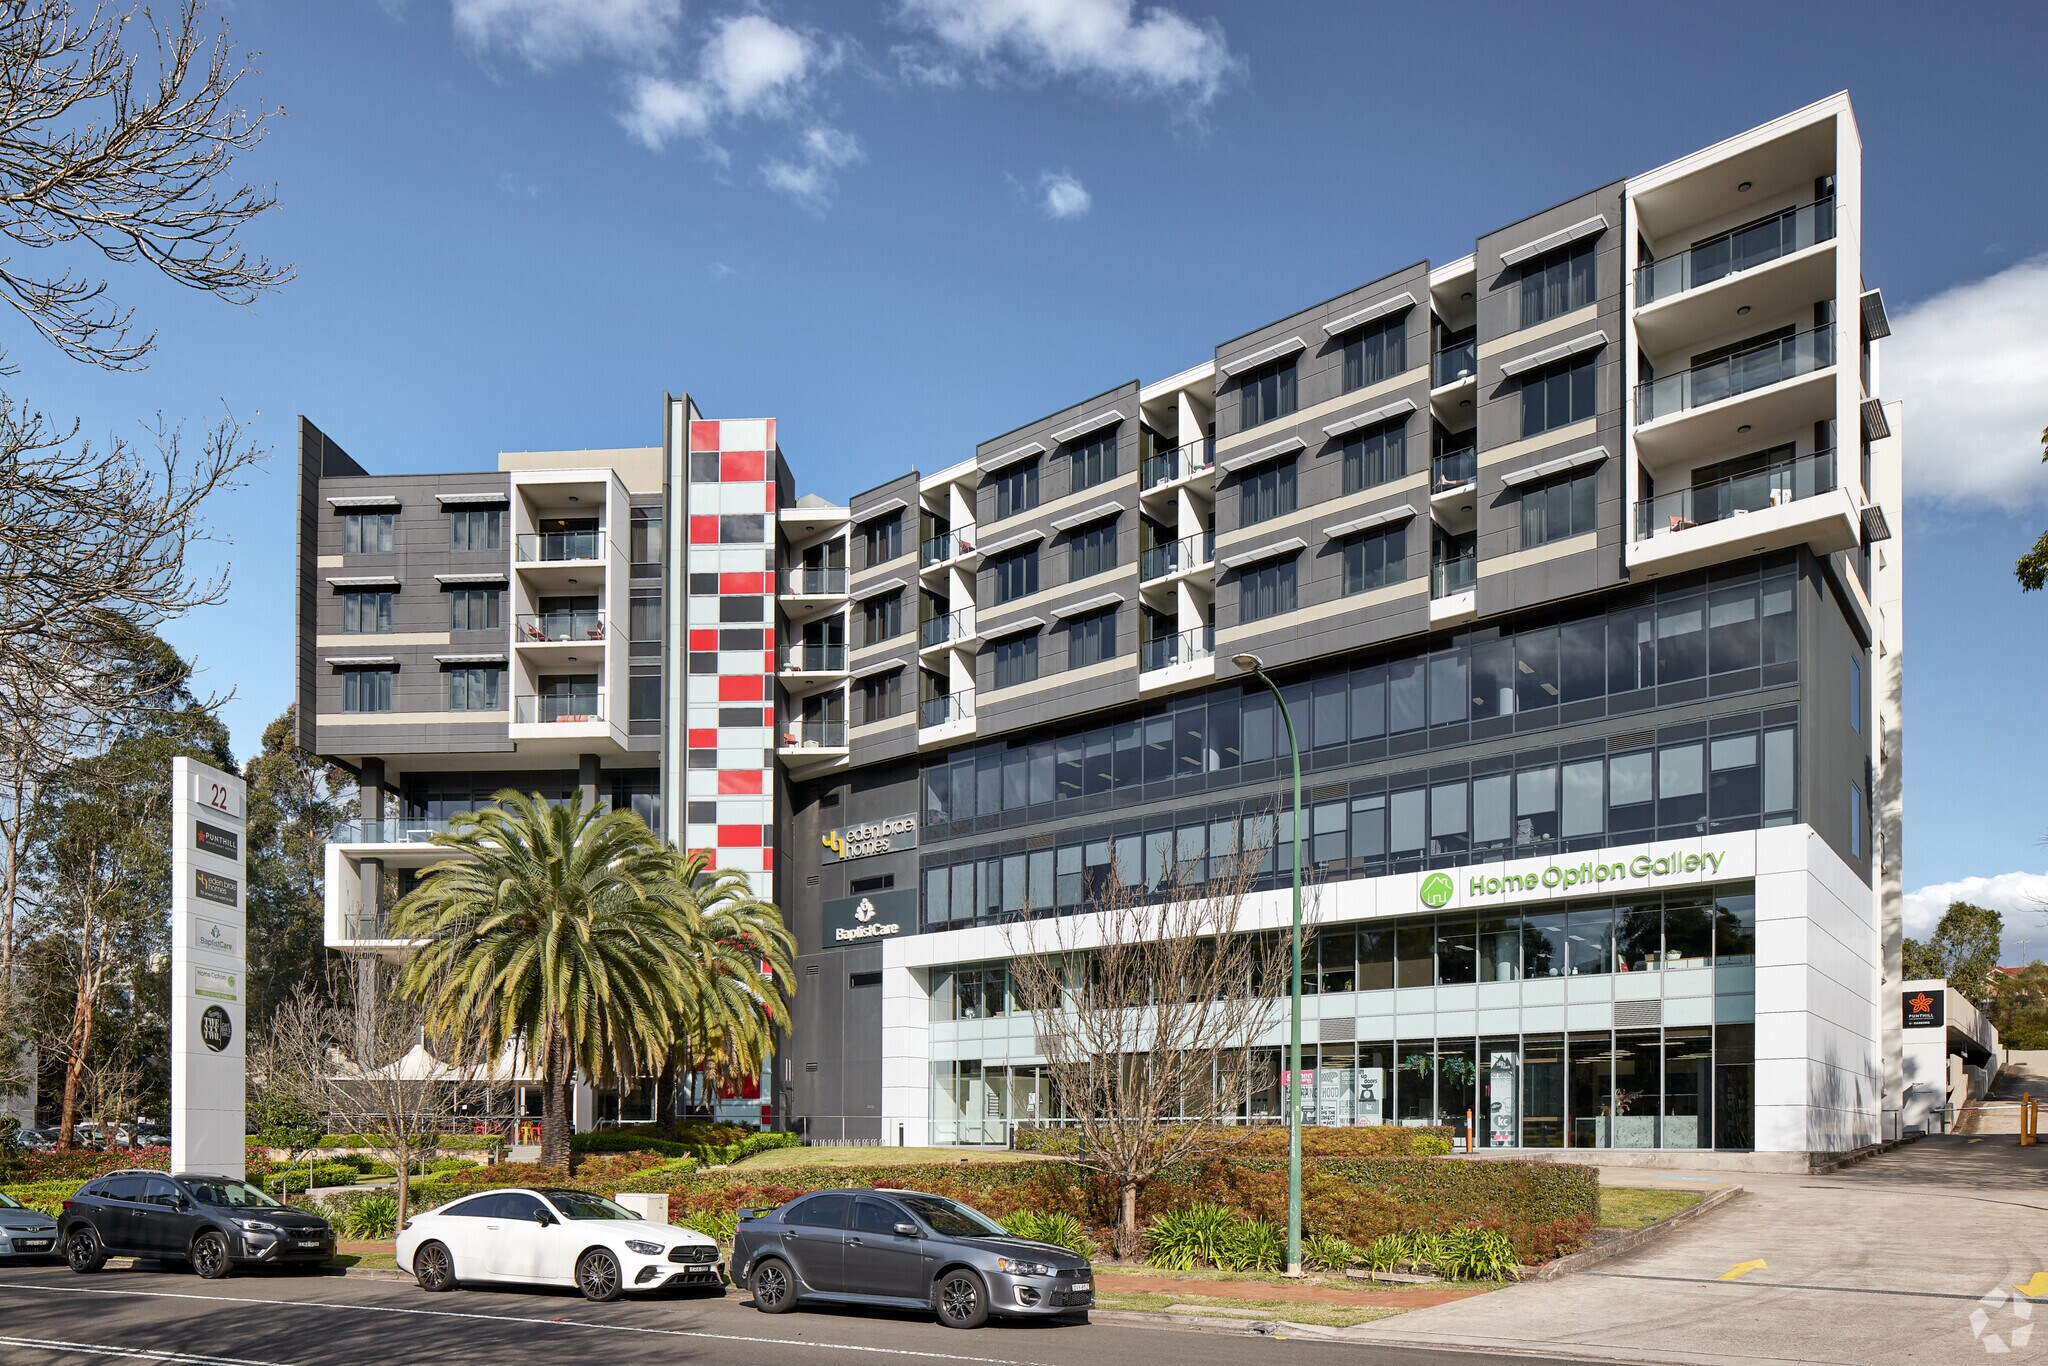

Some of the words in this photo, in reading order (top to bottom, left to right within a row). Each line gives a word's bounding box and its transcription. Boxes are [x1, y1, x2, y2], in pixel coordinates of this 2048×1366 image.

[212, 784, 227, 810] 22
[846, 823, 880, 843] eden
[882, 818, 914, 837] brae
[205, 832, 236, 848] PUNTHILL
[846, 838, 889, 858] homes
[1470, 873, 1539, 896] Home
[1542, 861, 1626, 890] Option
[1630, 850, 1725, 877] Gallery
[208, 877, 223, 888] eden
[208, 885, 227, 895] homes
[835, 922, 900, 941] BaptistCare
[200, 936, 232, 950] BaptistCare
[210, 972, 226, 980] Option
[1322, 1087, 1339, 1098] HOOD
[1497, 1116, 1508, 1126] kc
